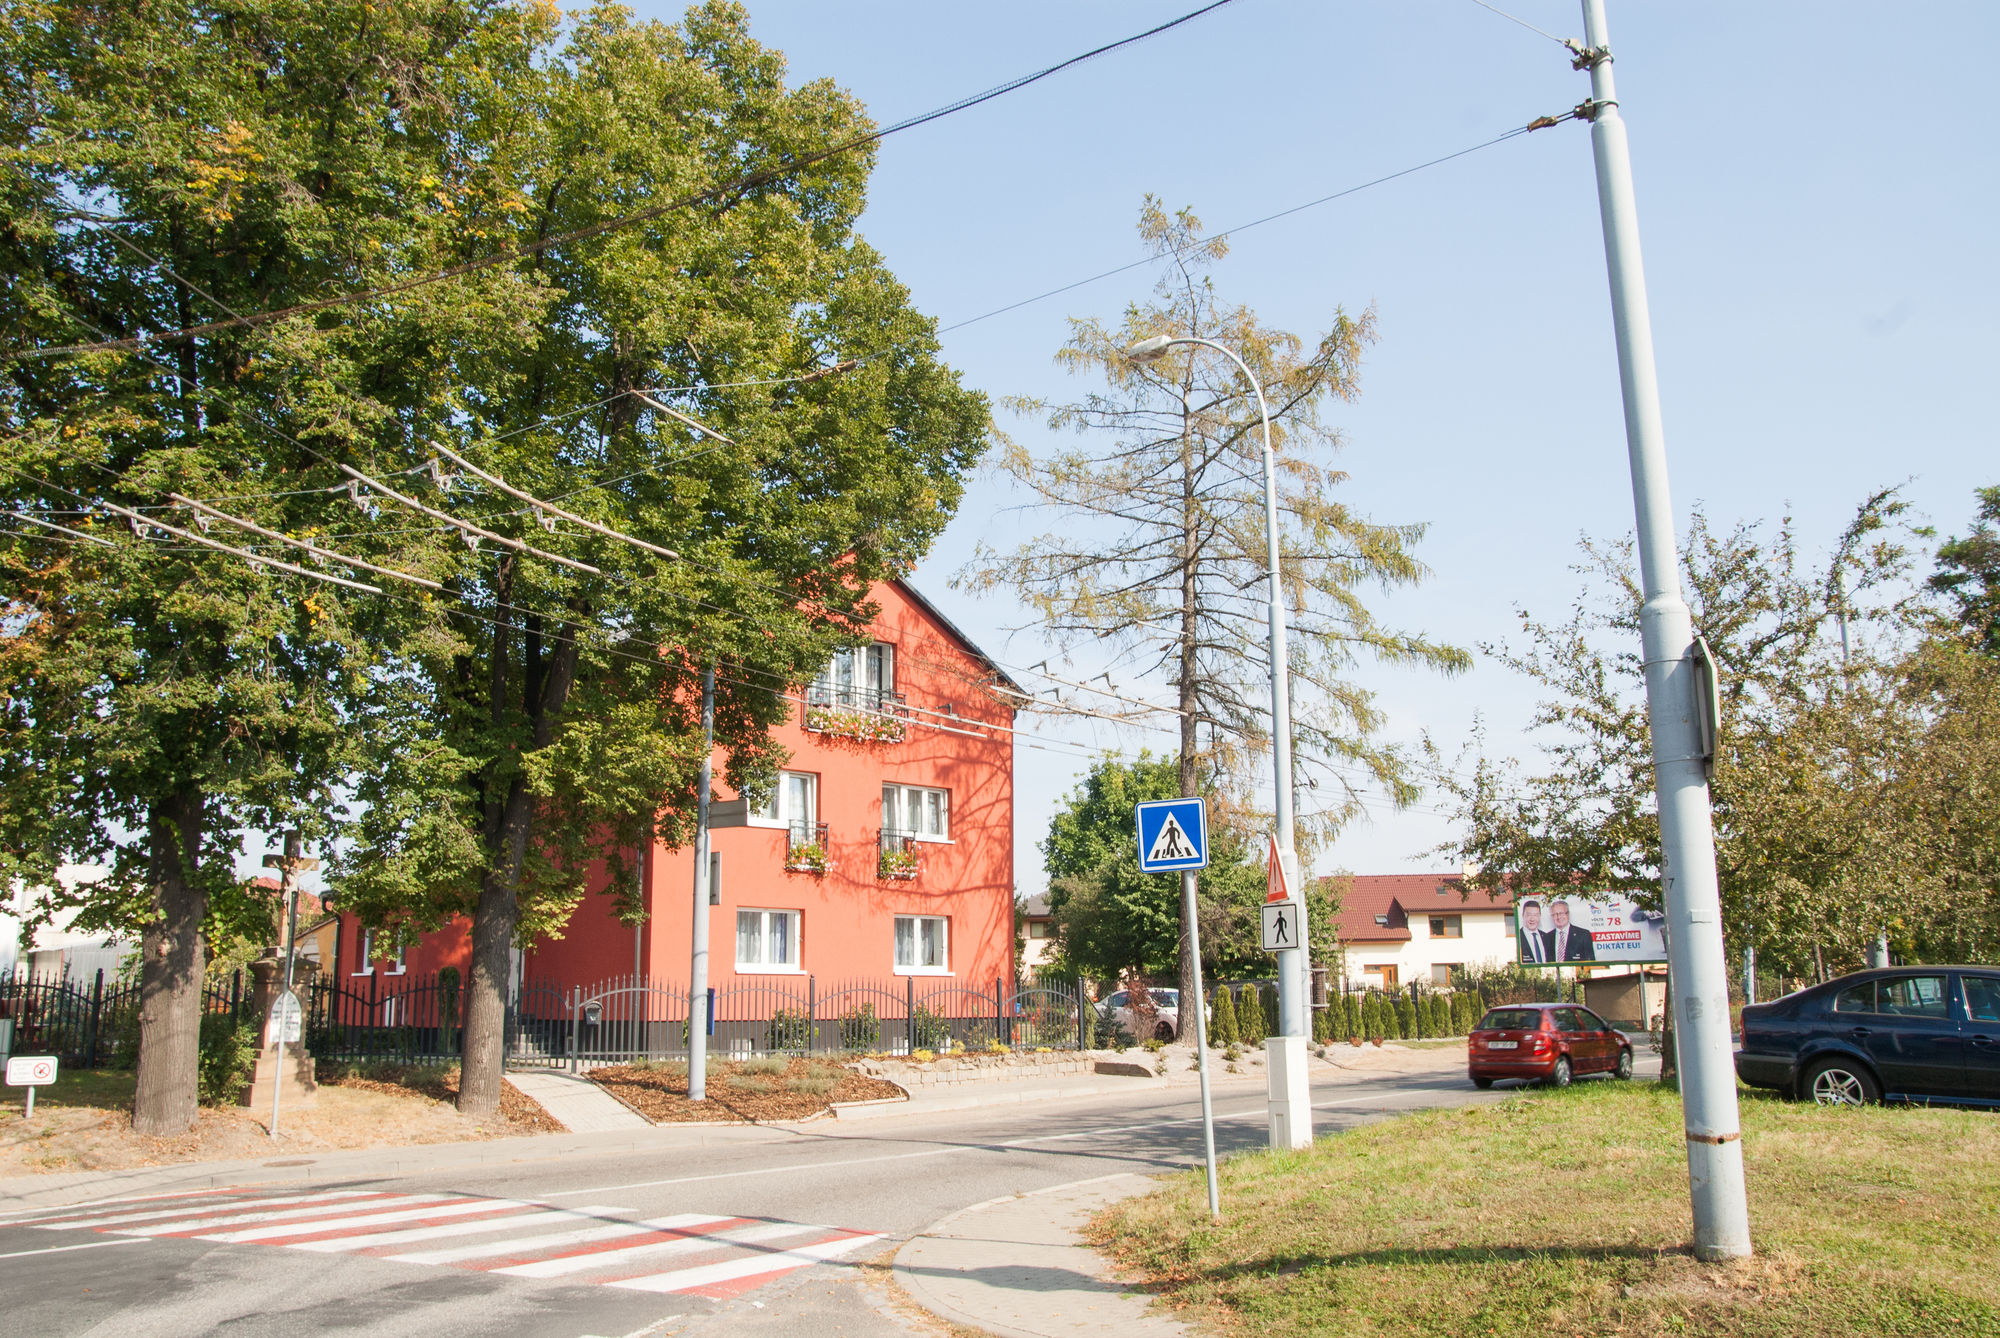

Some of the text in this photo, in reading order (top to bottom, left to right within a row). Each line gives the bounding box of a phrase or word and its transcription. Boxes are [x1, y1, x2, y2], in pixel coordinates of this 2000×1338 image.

[1607, 917, 1621, 926] 78
[1595, 932, 1640, 940] ZASTAVÍME
[1596, 942, 1625, 950] DIKTÁT
